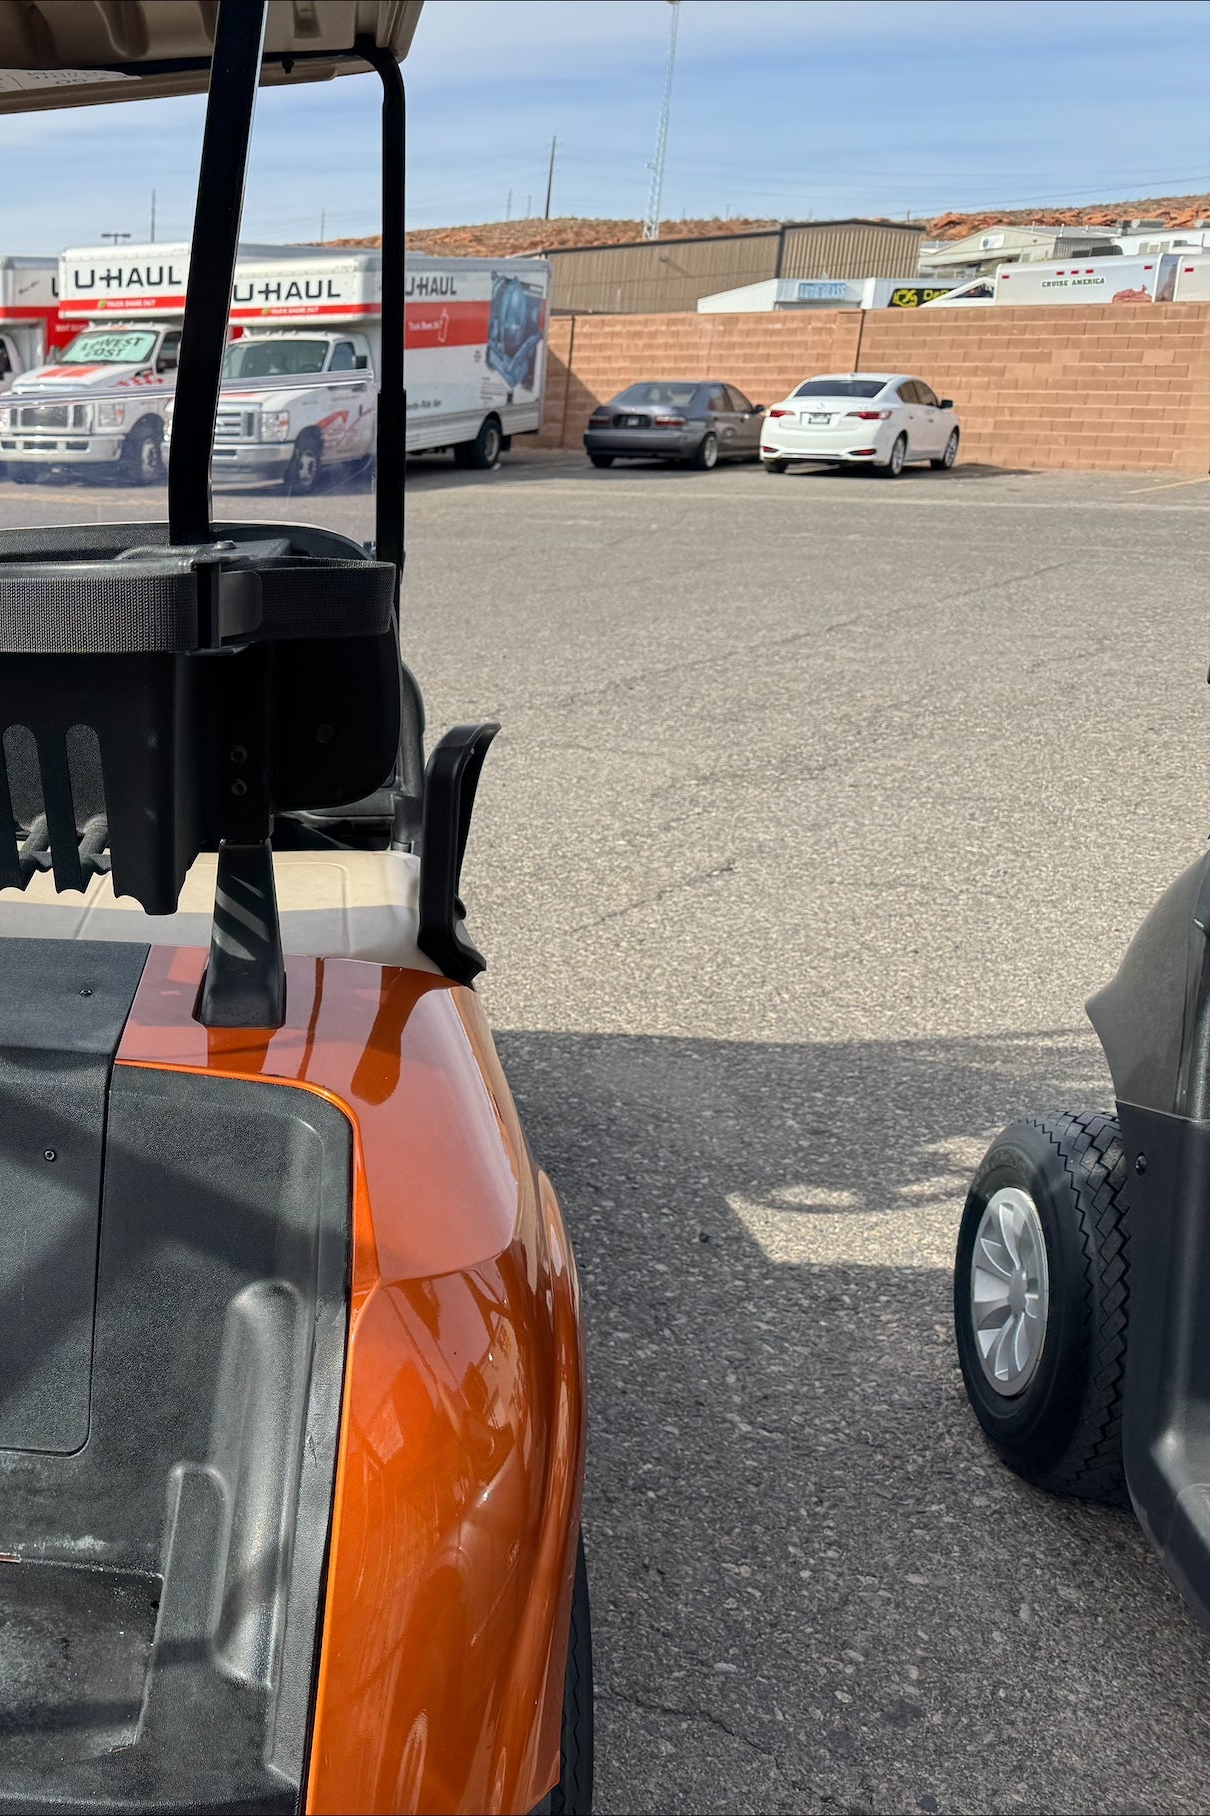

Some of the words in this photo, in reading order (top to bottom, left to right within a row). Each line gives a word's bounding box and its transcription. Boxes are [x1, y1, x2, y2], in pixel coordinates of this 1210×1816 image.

[75, 266, 181, 289] U-HAUL
[1042, 280, 1068, 288] CRUISE
[1072, 278, 1105, 286] AMERICA
[233, 280, 341, 302] U-HAUL
